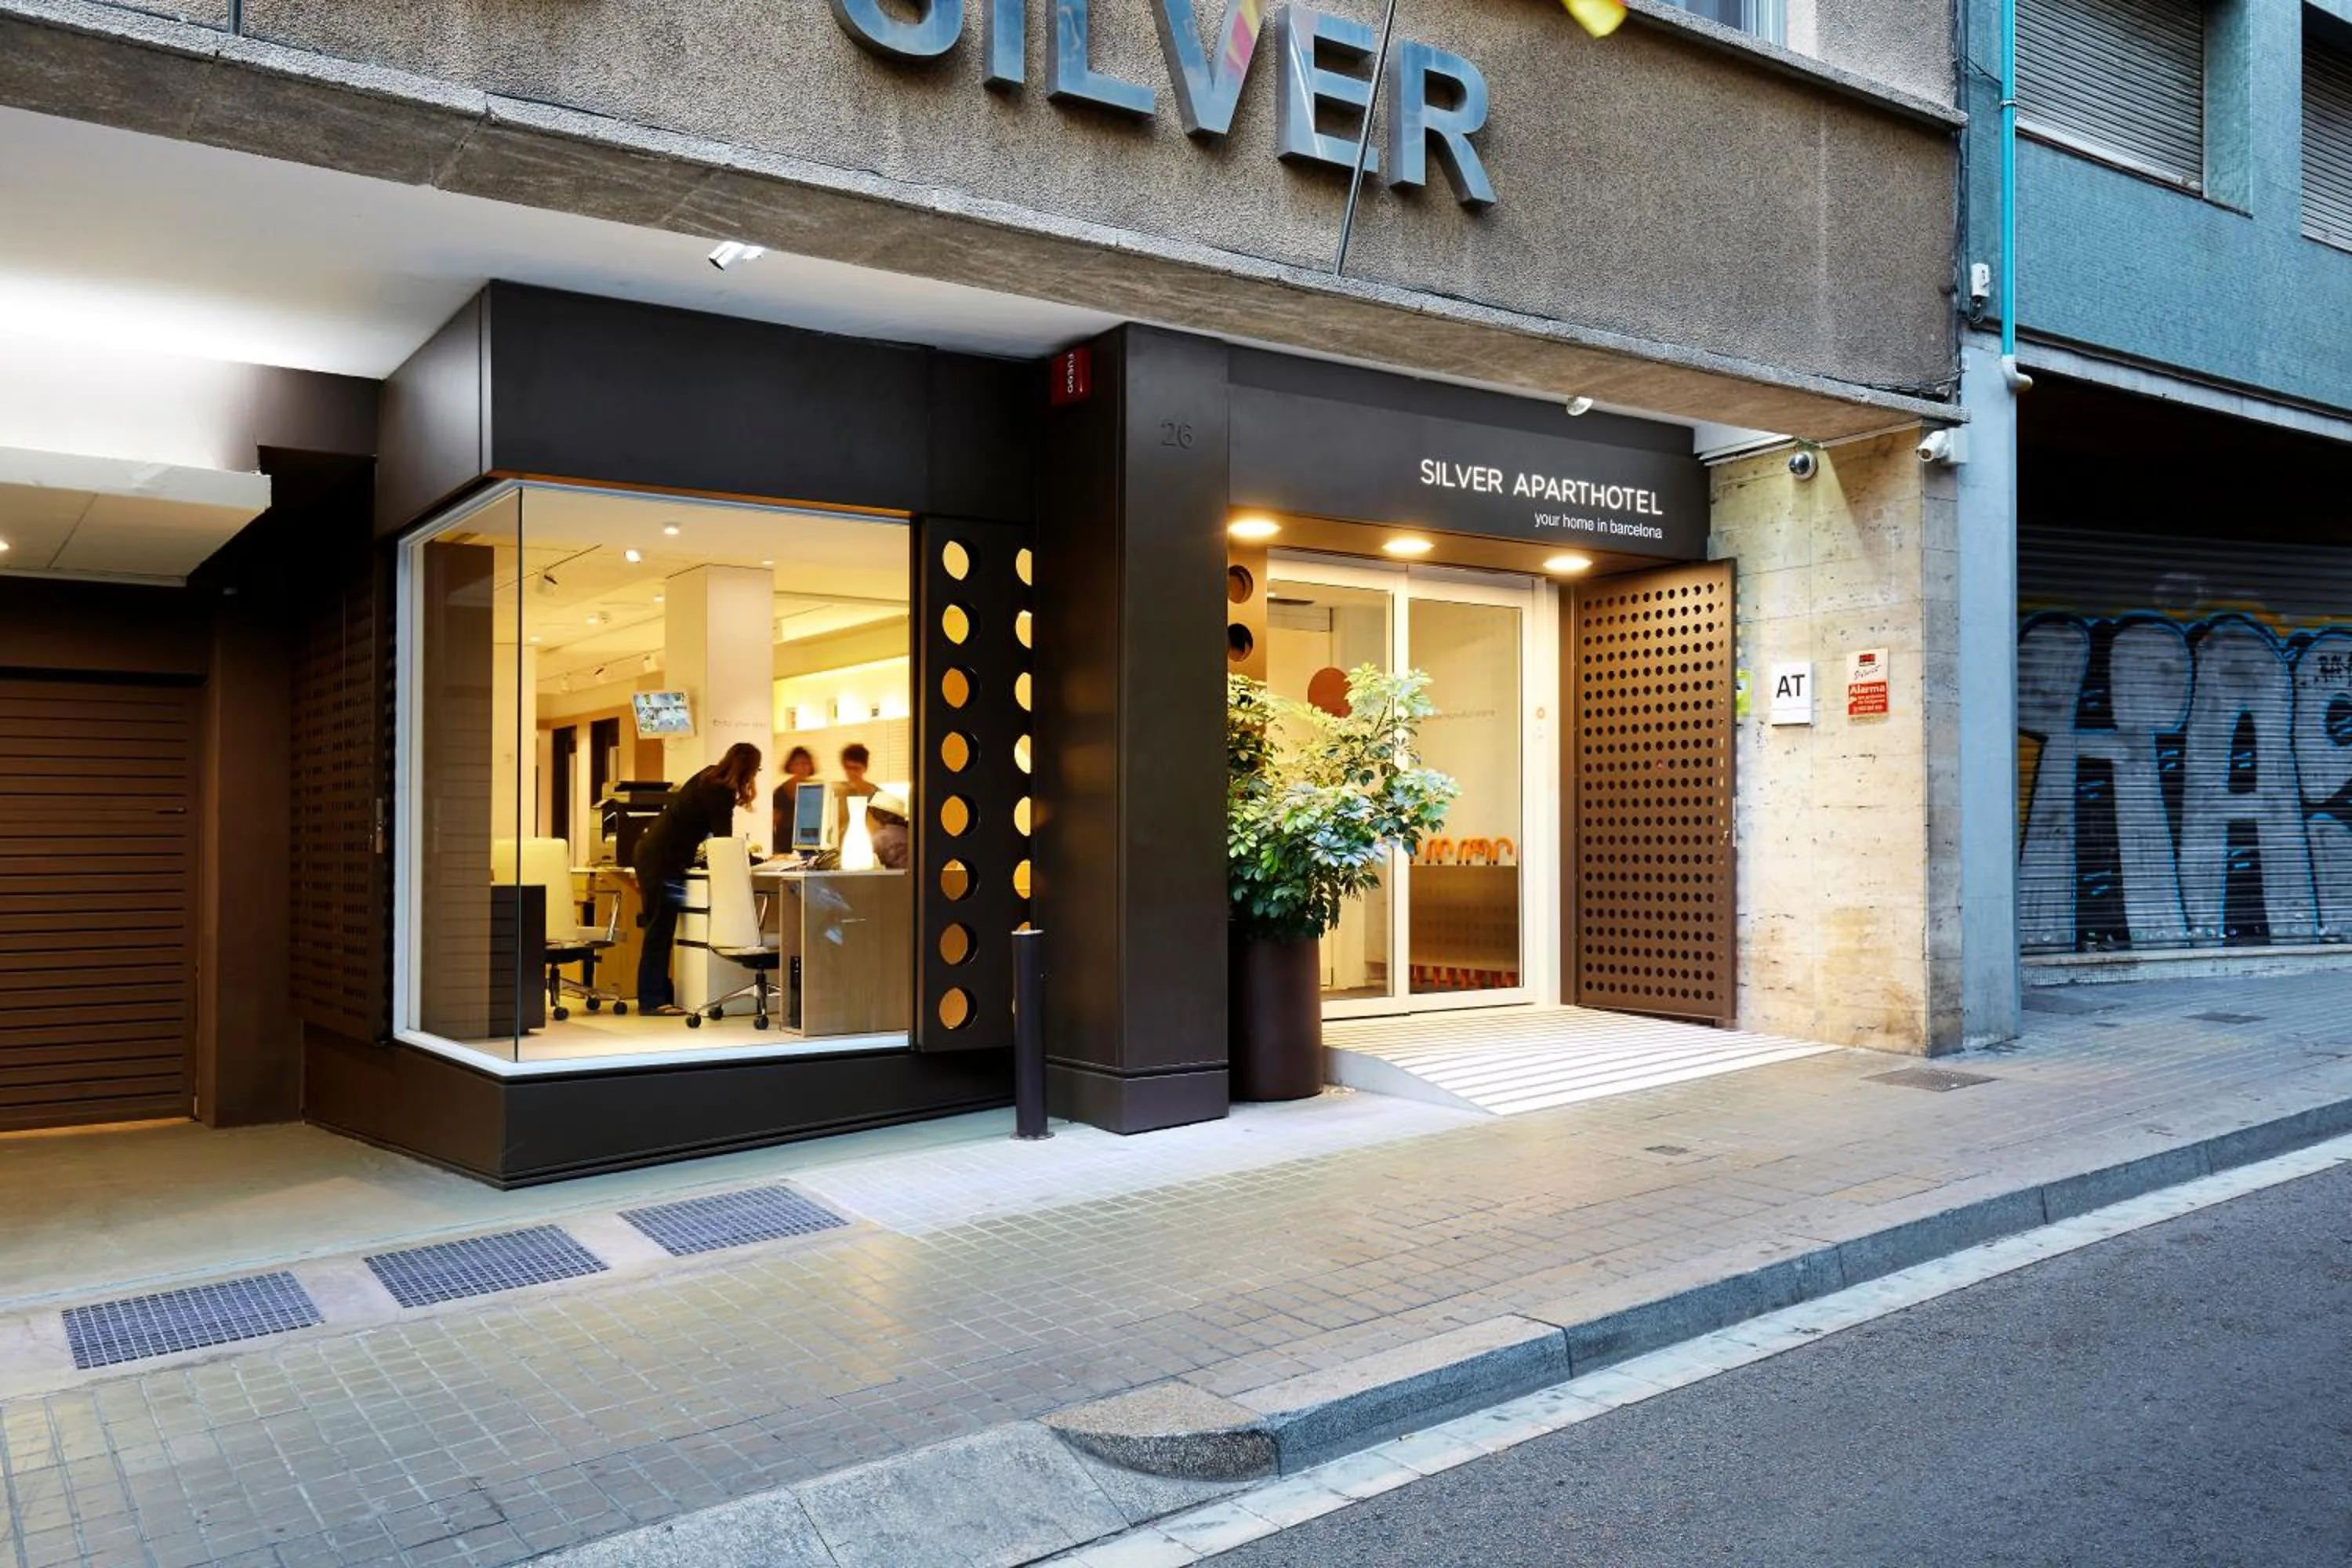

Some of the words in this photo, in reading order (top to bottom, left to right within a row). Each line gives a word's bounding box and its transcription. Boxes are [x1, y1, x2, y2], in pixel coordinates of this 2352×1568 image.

[1160, 417, 1193, 450] 26
[1420, 459, 1503, 495] SILVER
[1513, 473, 1663, 515] APARTHOTEL
[1534, 512, 1560, 528] your
[1563, 514, 1594, 532] home
[1597, 517, 1607, 533] in
[1610, 519, 1663, 539] barcelona
[1776, 673, 1806, 698] AT
[1849, 684, 1886, 695] Alarma
